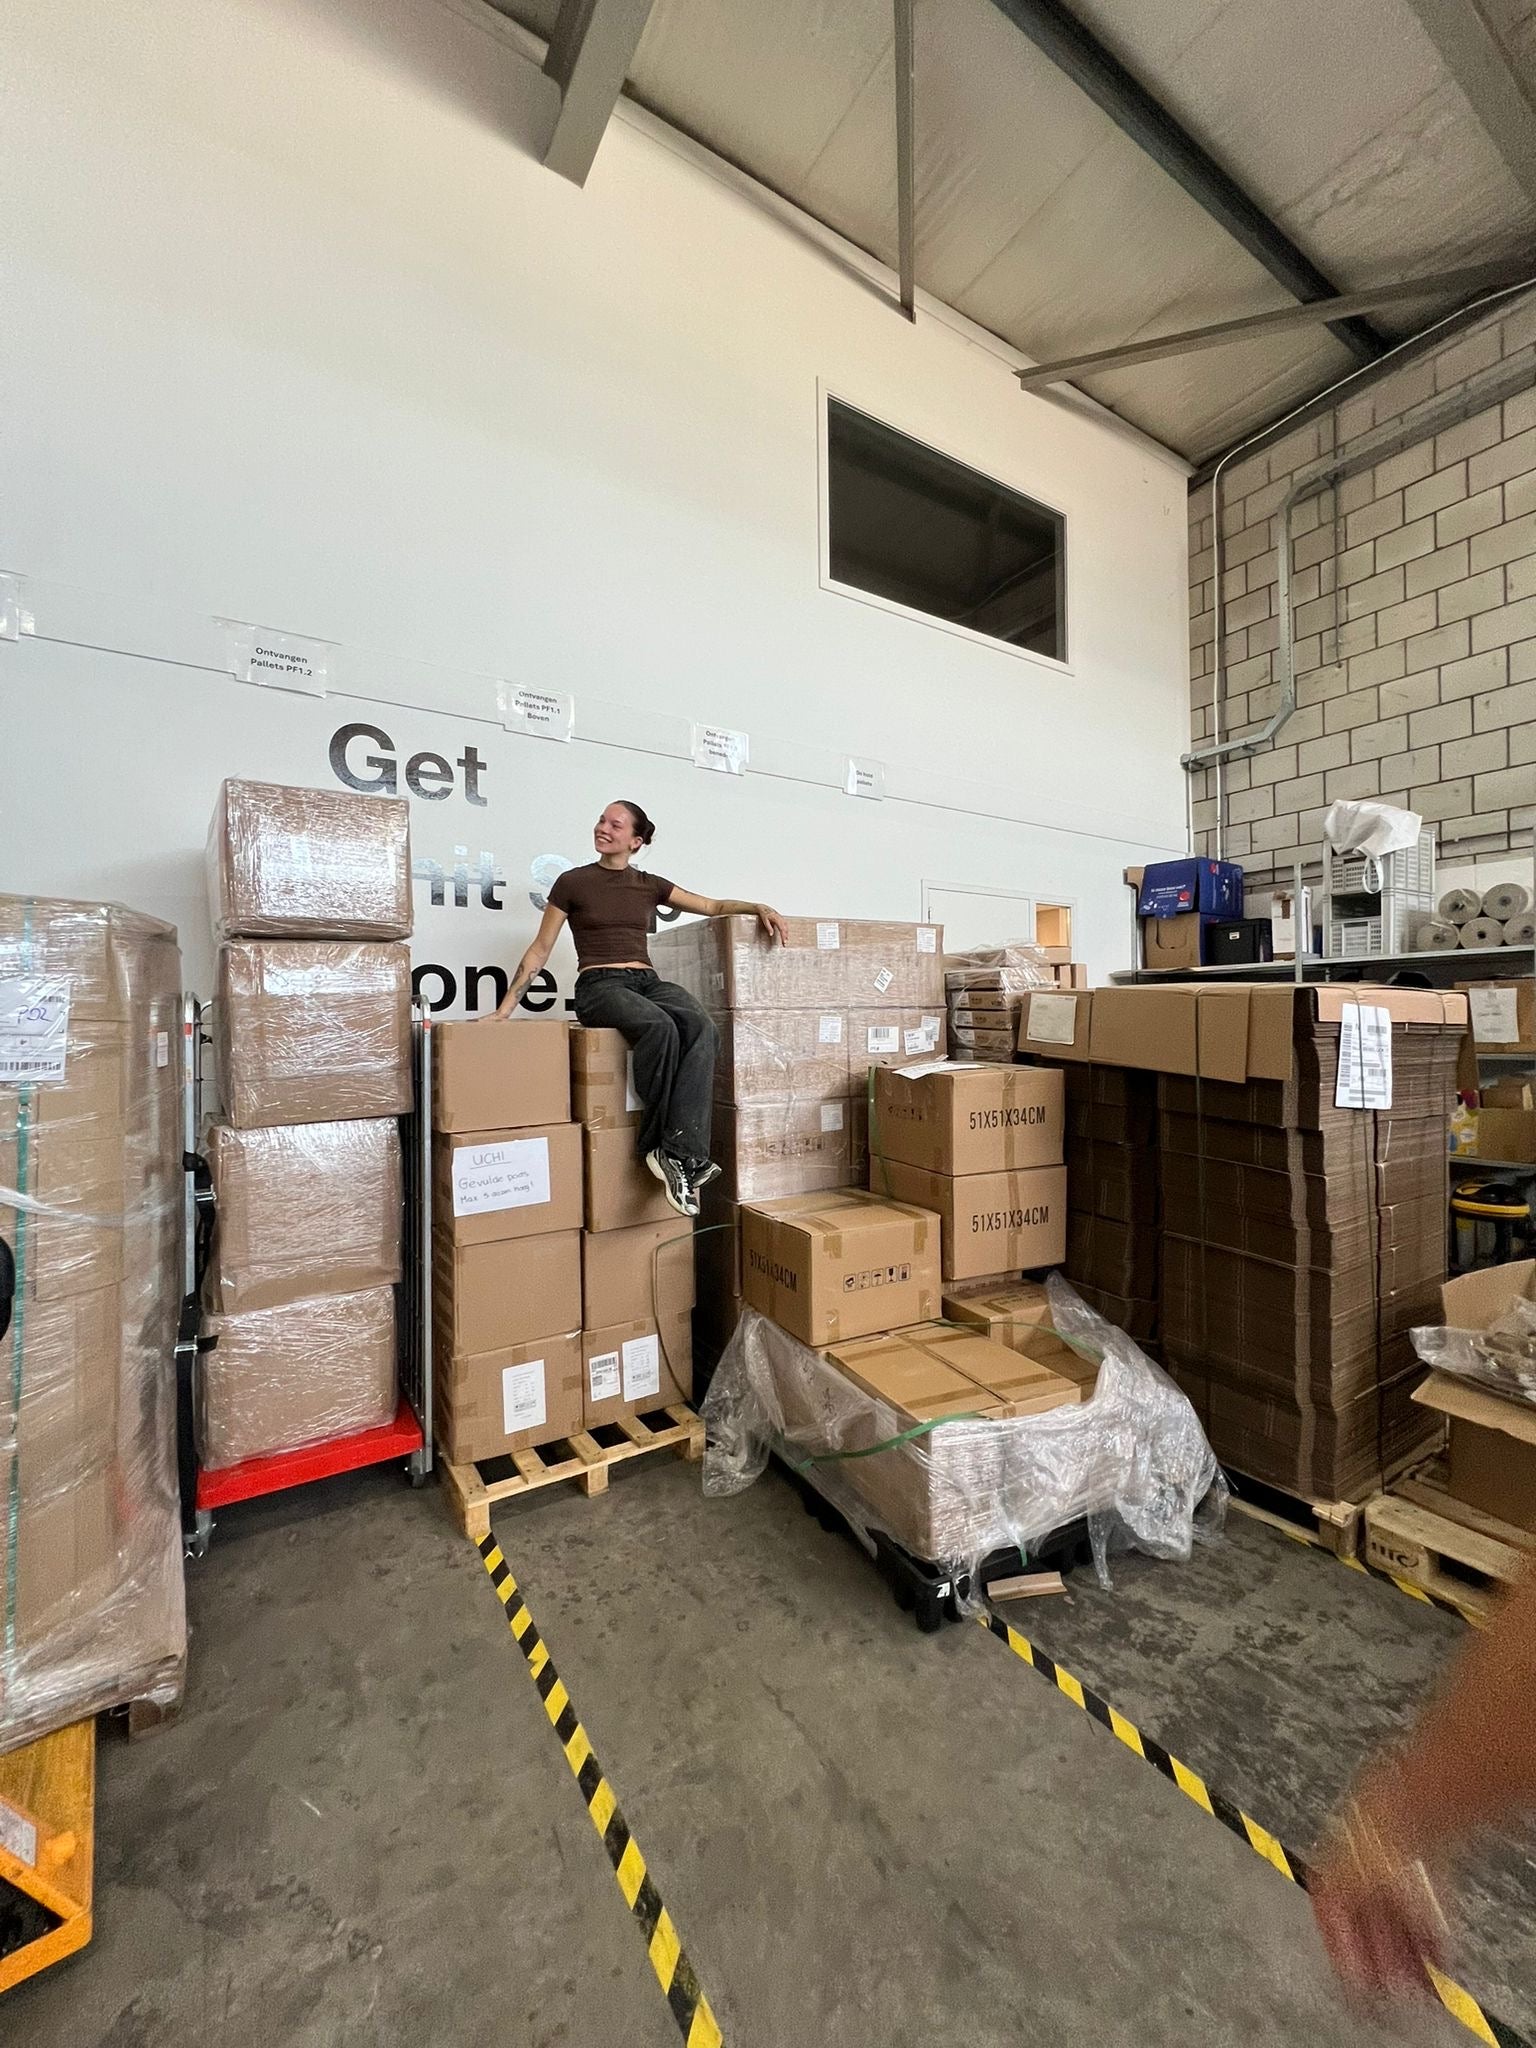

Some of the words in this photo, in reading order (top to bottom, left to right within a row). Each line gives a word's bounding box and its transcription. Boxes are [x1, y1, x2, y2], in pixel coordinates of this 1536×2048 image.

[255, 647, 308, 664] Ontvangen
[250, 657, 284, 671] Pallets
[286, 664, 313, 677] PF1.2
[527, 712, 550, 722] Boven
[328, 722, 488, 808] Get
[969, 1105, 1046, 1130] 51X51X34CM
[472, 1150, 505, 1166] UCHI
[458, 1175, 504, 1190] Gevulde
[460, 1195, 480, 1205] Max
[971, 1205, 1049, 1234] 51X51X34CM
[749, 1248, 798, 1293] 51X51X34CM
